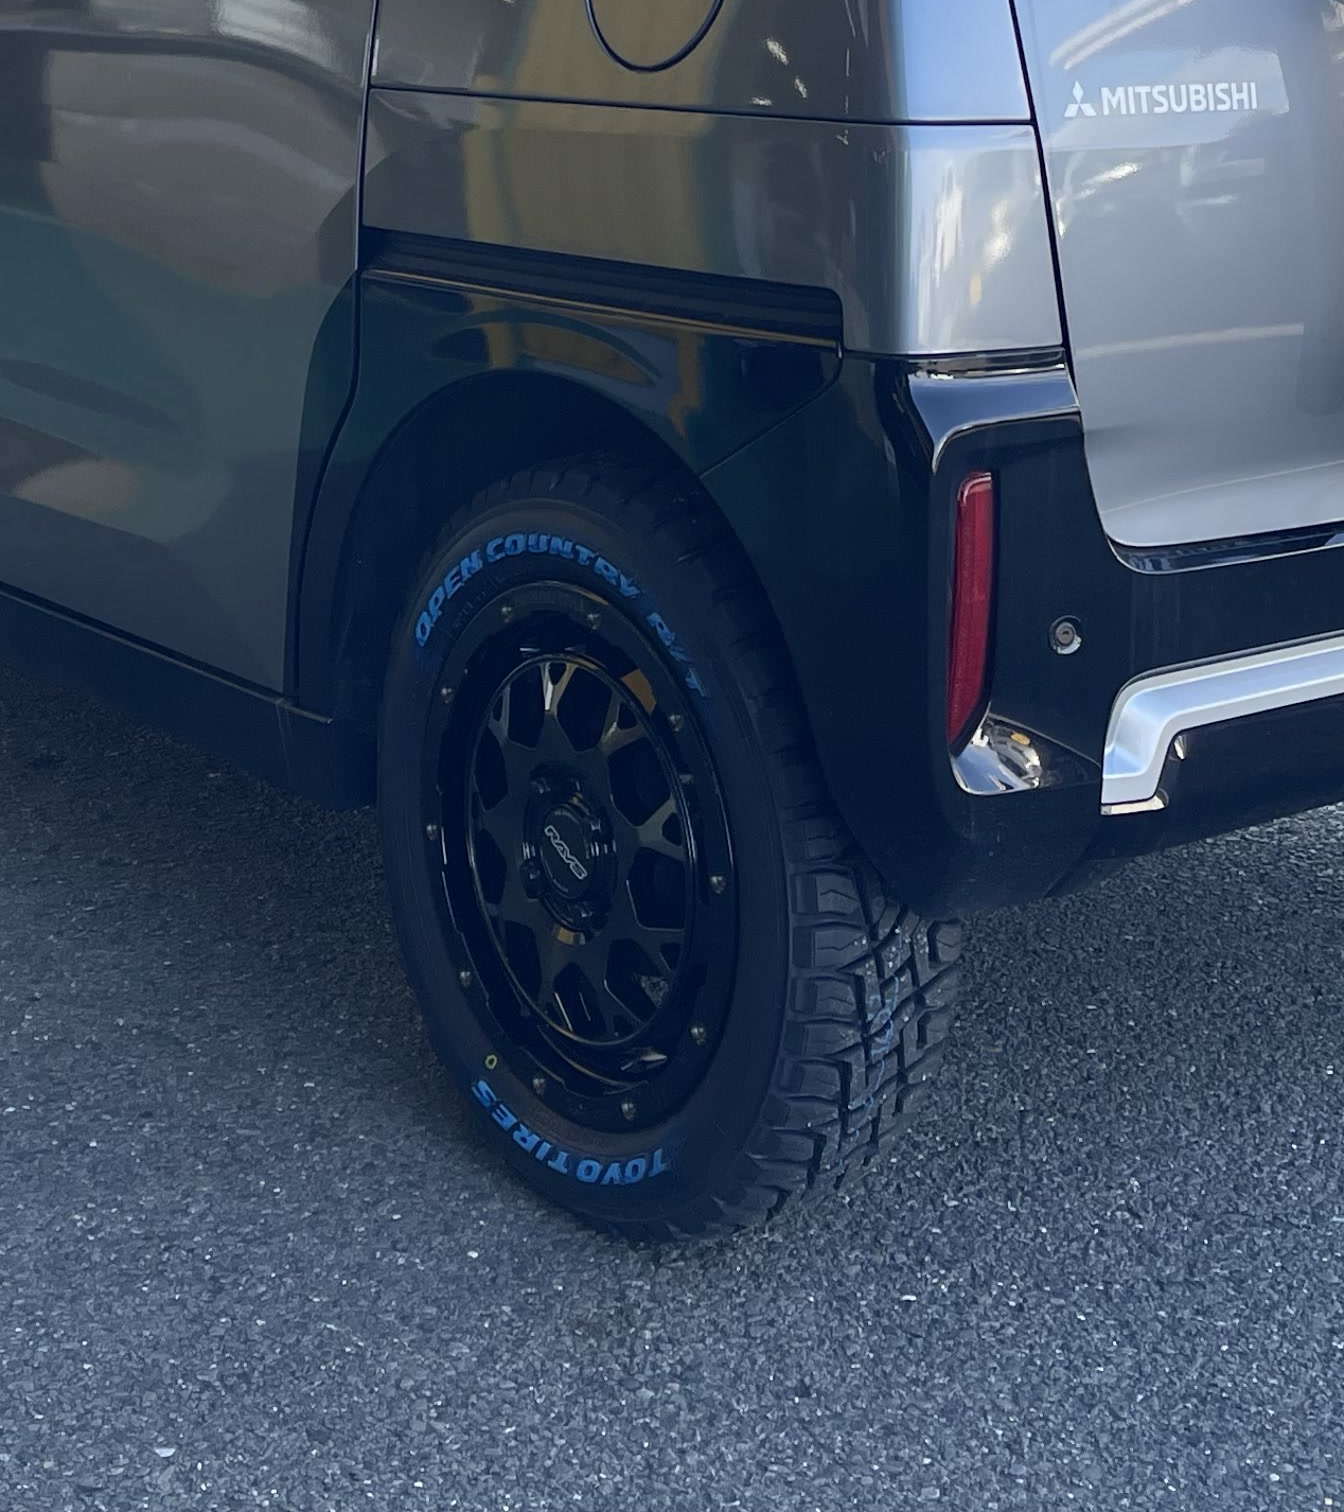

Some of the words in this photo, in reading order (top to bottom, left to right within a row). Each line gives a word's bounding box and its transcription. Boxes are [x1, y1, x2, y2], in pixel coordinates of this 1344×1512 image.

[1101, 82, 1257, 115] MITSUBISHI
[416, 549, 484, 647] OPEN
[487, 532, 641, 598] COUNTRY
[646, 612, 706, 697] R/T
[544, 825, 587, 879] RAYS
[472, 1080, 570, 1174] TIRES
[576, 1149, 669, 1185] TOYO
